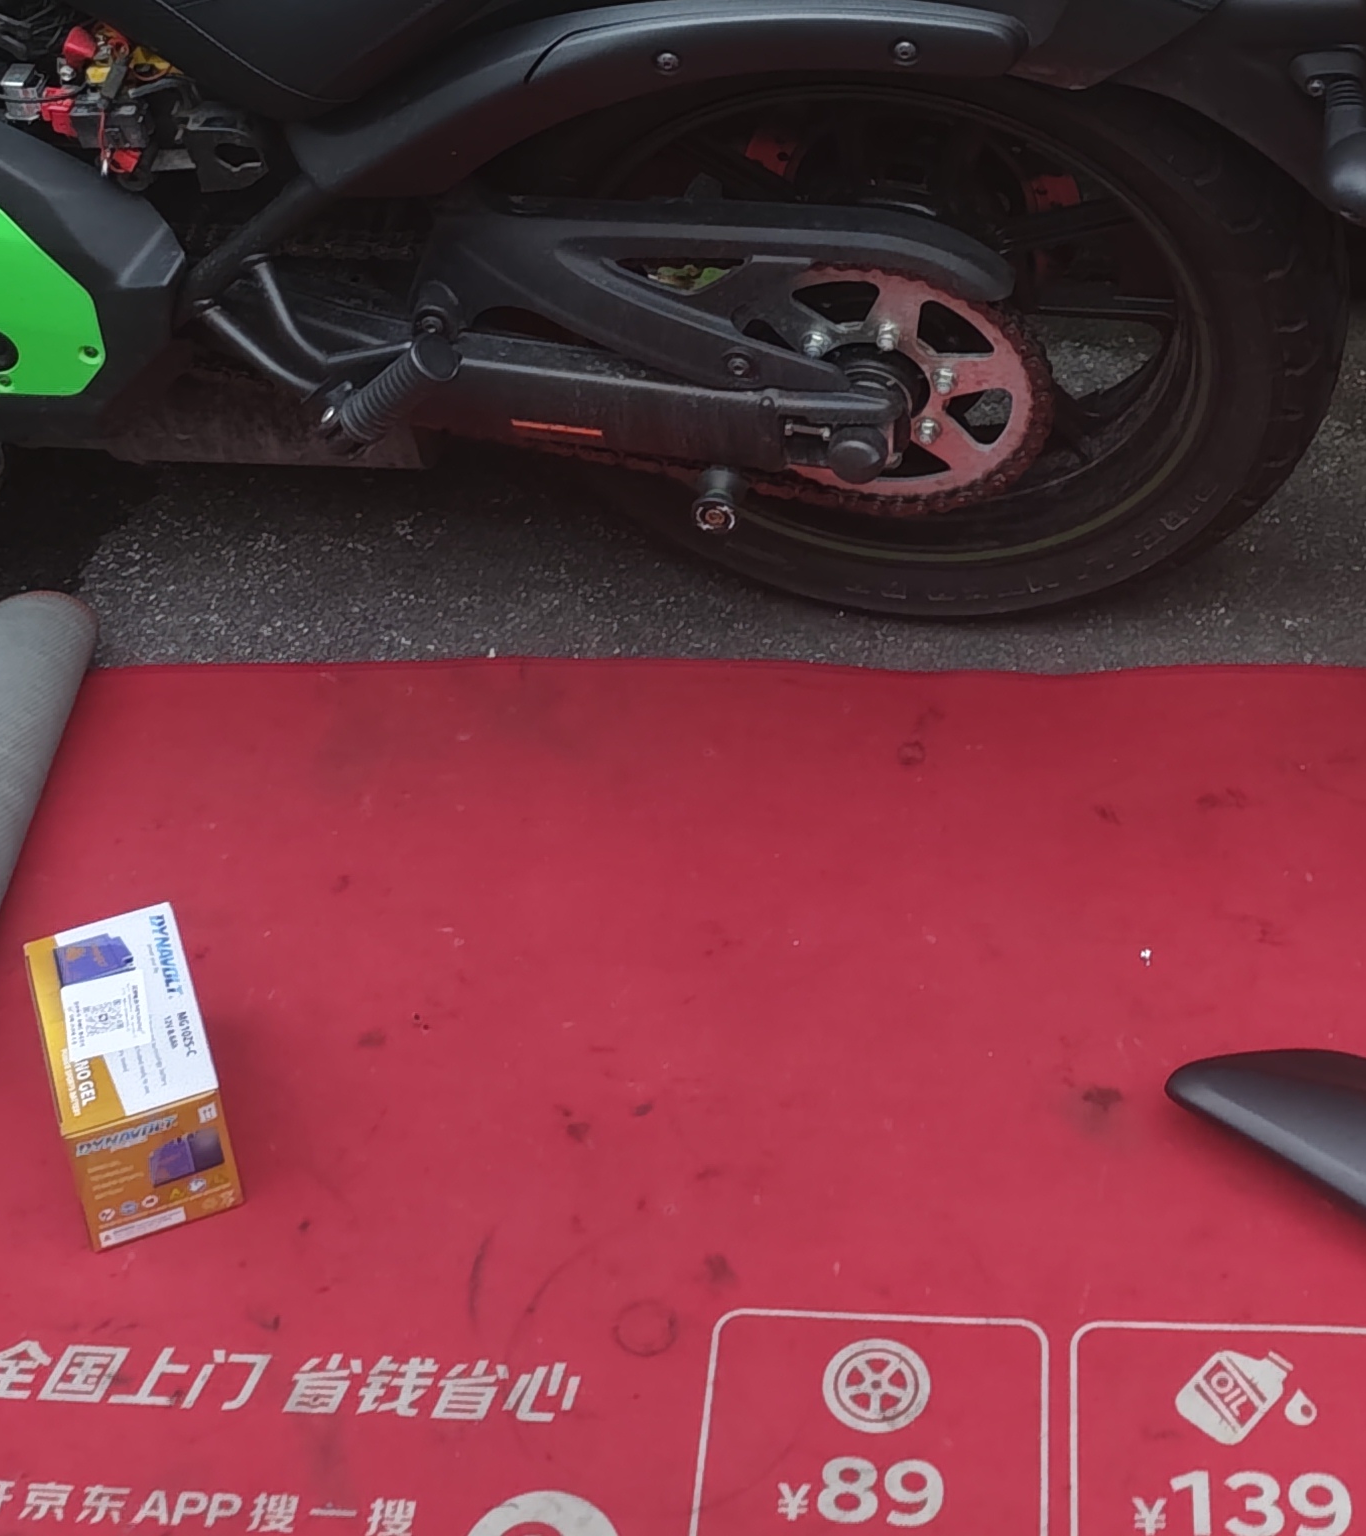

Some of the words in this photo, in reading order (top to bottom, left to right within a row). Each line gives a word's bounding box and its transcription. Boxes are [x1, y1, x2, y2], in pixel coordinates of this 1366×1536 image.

[149, 914, 184, 996] DYNAVOLT
[73, 1059, 92, 1081] NO
[78, 1081, 97, 1108] GEL
[283, 1351, 582, 1424] 省钱省心
[1209, 1370, 1249, 1417] OIL
